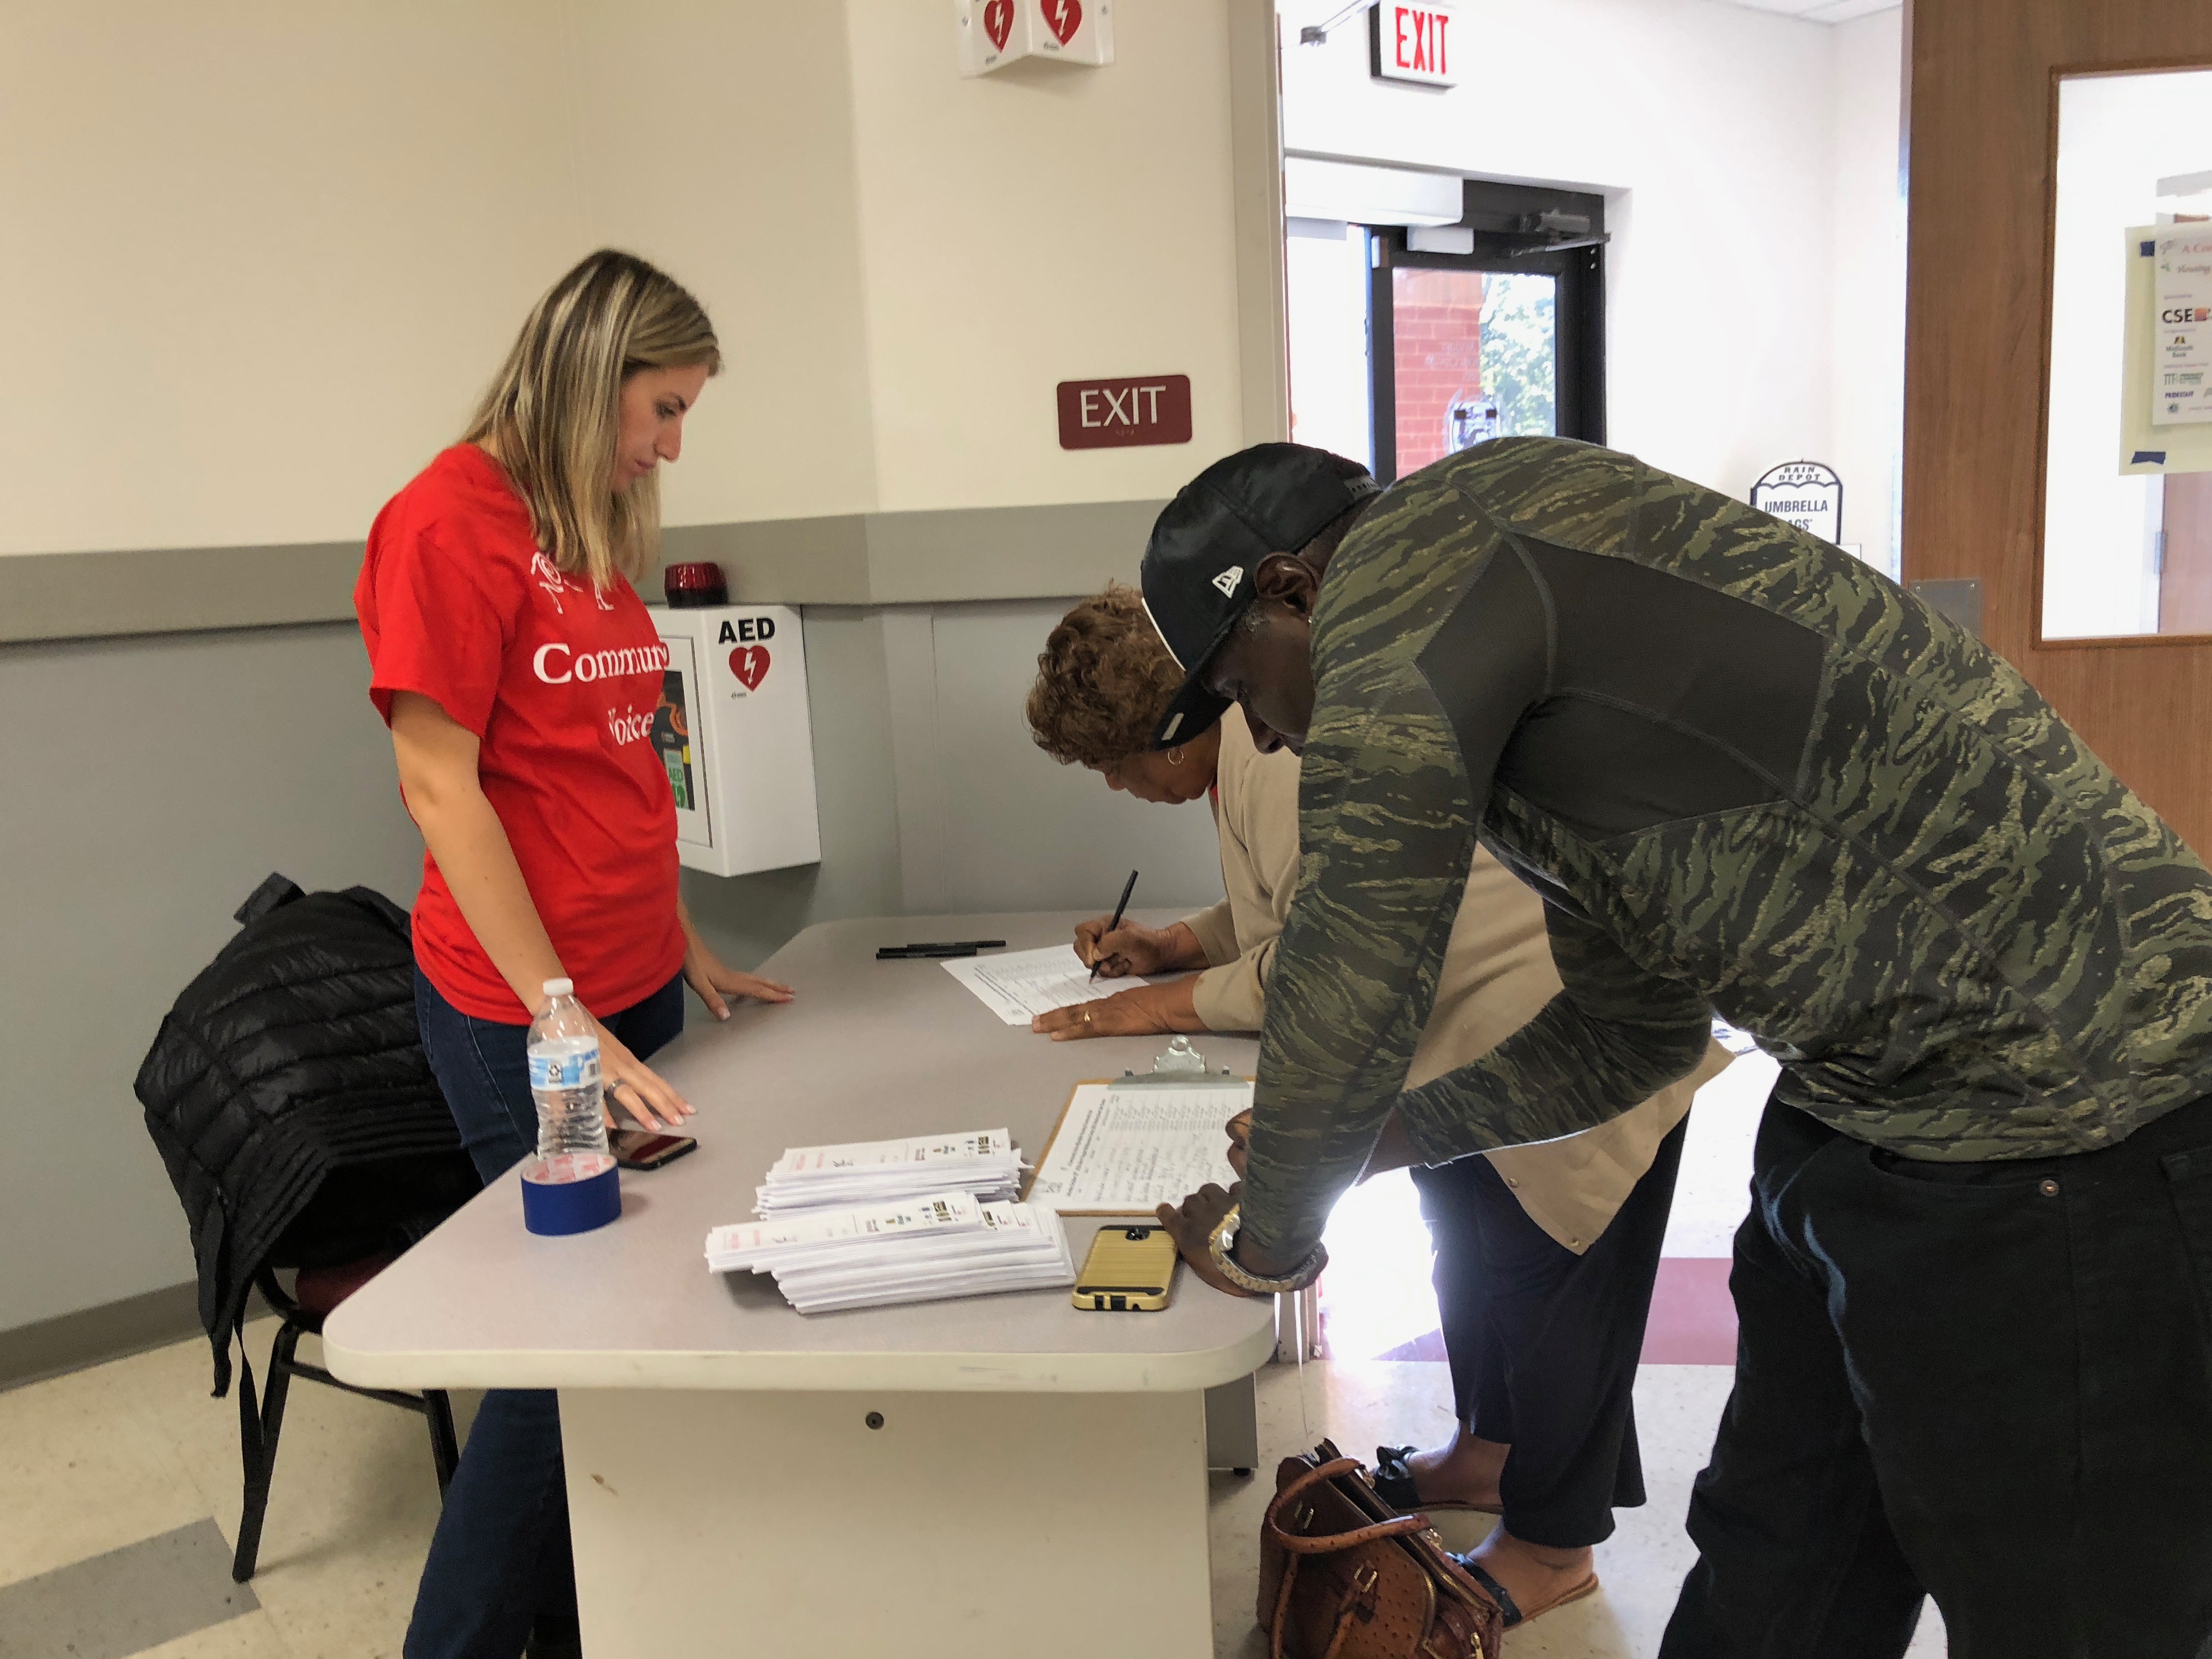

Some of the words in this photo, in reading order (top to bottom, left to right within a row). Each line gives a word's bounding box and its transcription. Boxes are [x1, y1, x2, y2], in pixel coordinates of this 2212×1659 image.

[1395, 5, 1449, 76] EXIT
[2162, 309, 2193, 324] CSE
[1080, 385, 1167, 428] EXIT
[1765, 500, 1828, 513] UMBRELLA
[718, 617, 775, 645] AED
